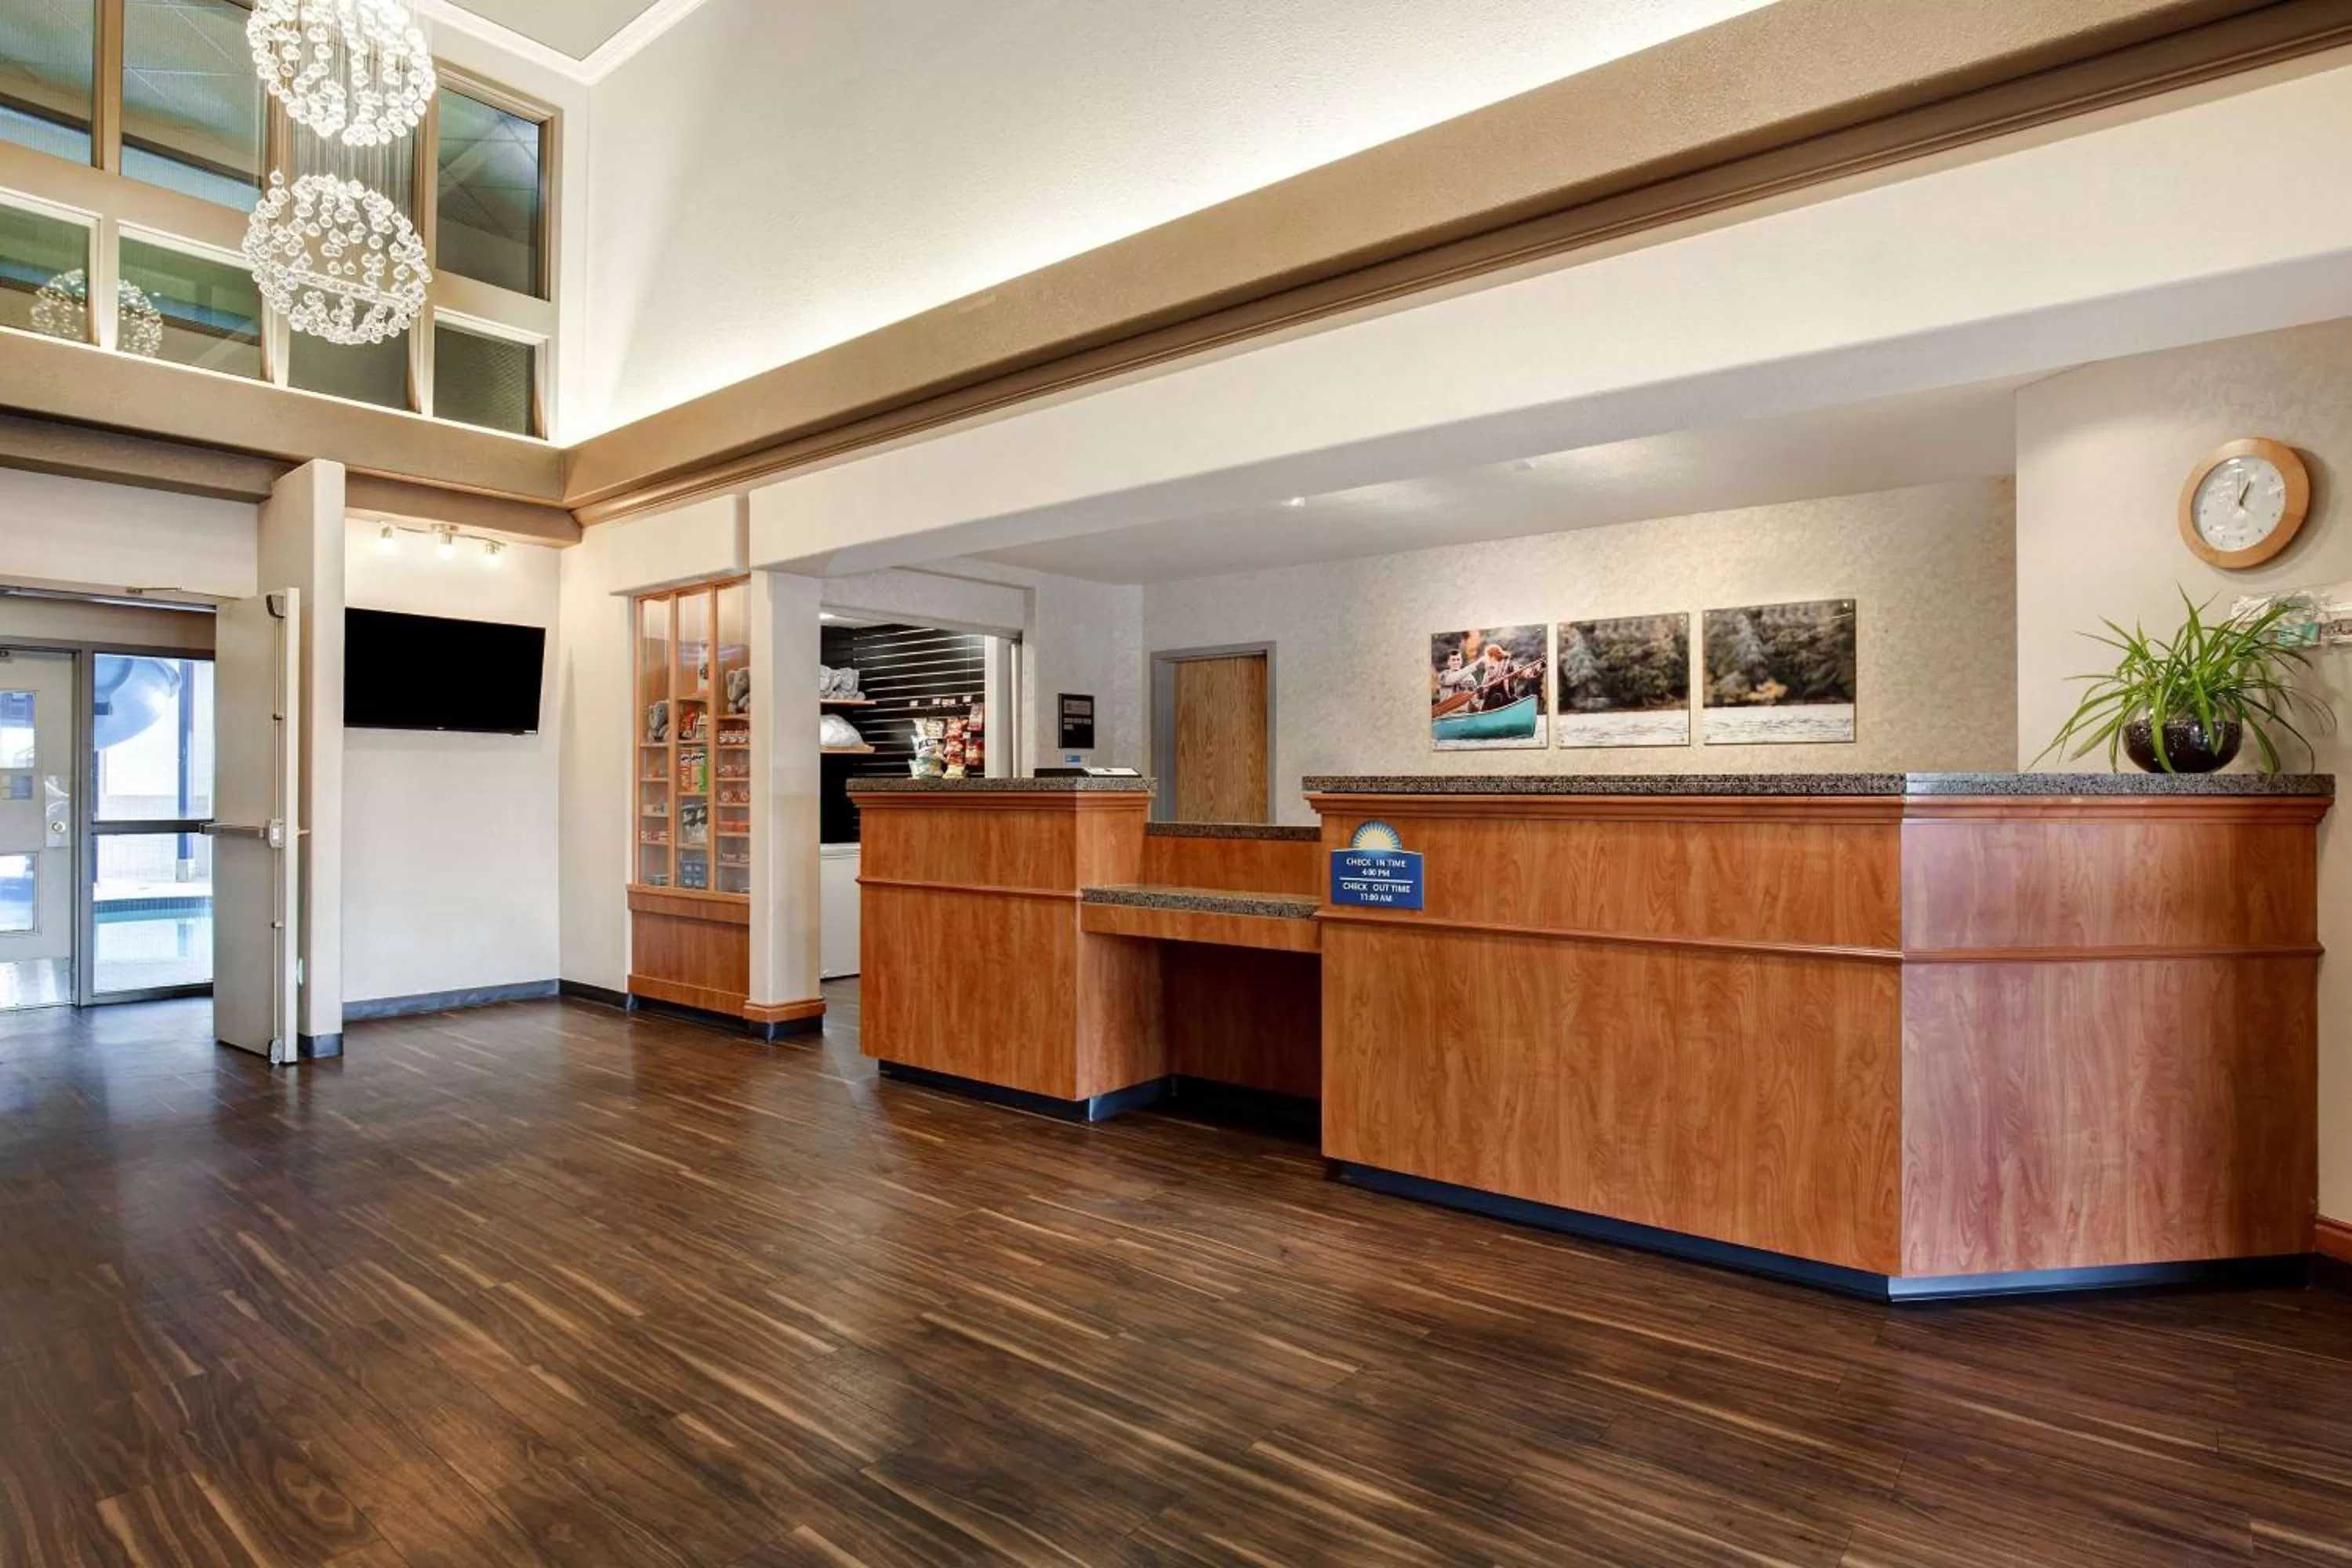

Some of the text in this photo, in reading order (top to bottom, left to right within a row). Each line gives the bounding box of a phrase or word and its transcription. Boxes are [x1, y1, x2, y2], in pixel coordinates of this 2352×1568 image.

[1346, 858, 1371, 866] CHECK
[1388, 859, 1407, 868] TIME
[1343, 882, 1410, 893] CHECK OUT TIME
